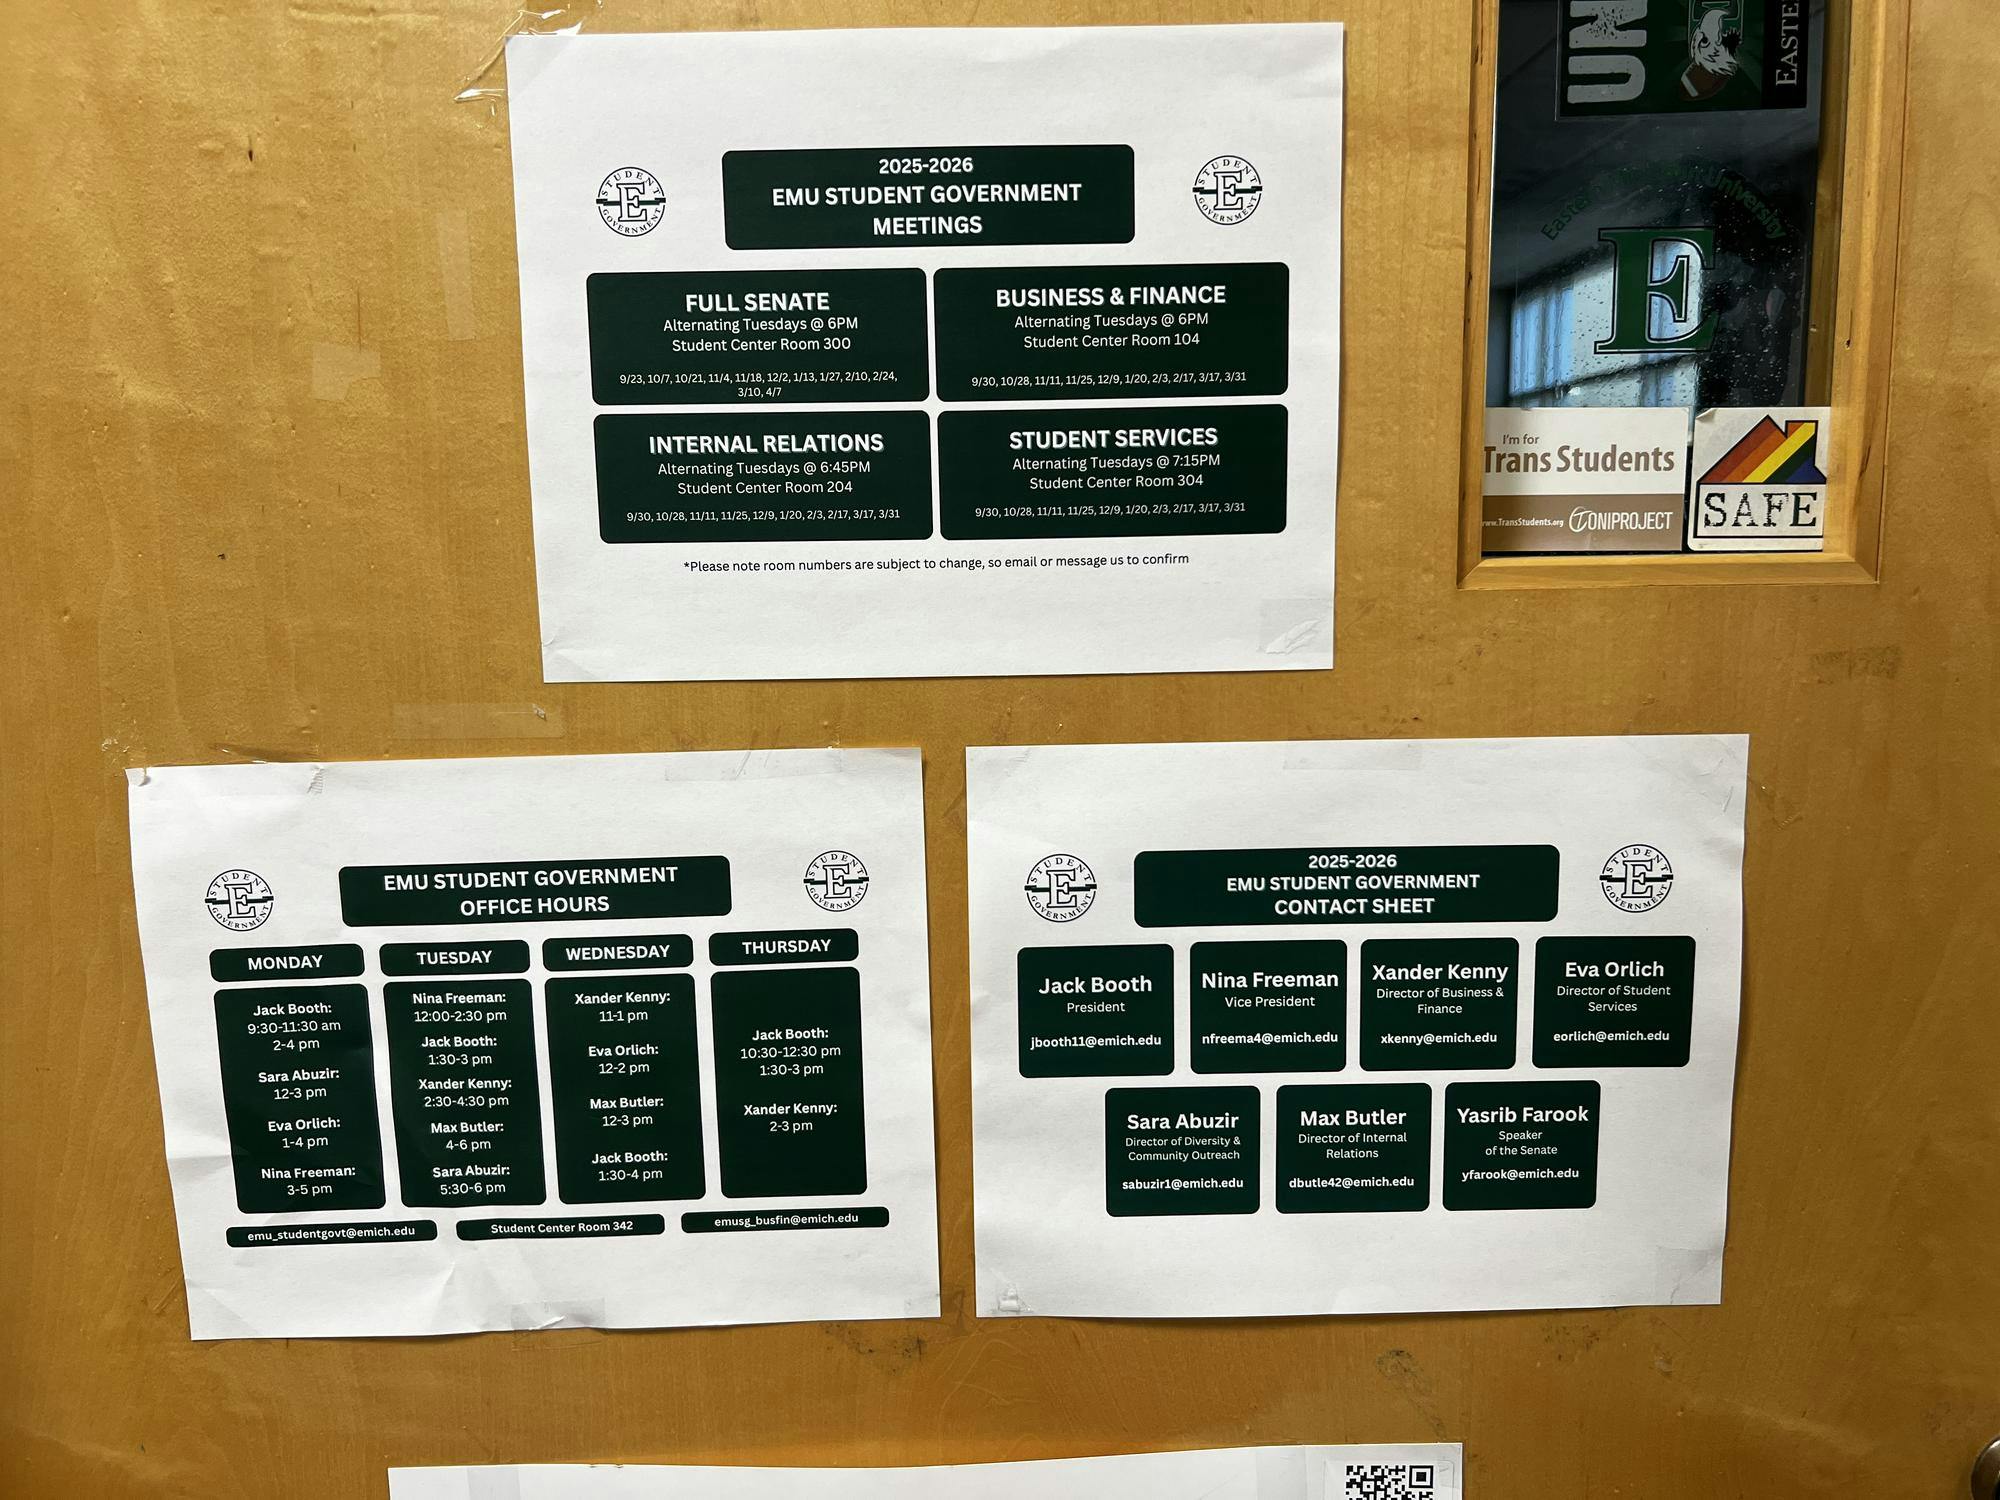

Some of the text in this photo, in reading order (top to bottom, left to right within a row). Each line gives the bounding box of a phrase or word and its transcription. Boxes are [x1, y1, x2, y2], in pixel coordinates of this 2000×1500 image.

[879, 157, 974, 174] 2025-2026
[601, 170, 661, 196] STUDENT
[772, 183, 1082, 206] EMU STUDENT GOVERNMENT
[602, 208, 661, 234] GOVERNMENT
[873, 215, 983, 235] MEETINGS
[996, 285, 1226, 308] BUSINESS & FINANCE
[1594, 227, 1719, 355] E
[686, 292, 830, 312] FULL SENATE
[663, 316, 858, 334] Alternating Tuesdays @ 6PM
[672, 337, 851, 352] Student Center Room 300
[649, 433, 884, 454] INTERNAL RELATIONS
[1010, 427, 1218, 450] STUDENT SERVICES
[1523, 434, 1540, 445] for
[1484, 444, 1675, 474] Trans Students
[975, 502, 1245, 518] 9/30, 10/28, 11/11, 11/25, 12/9, 1/20, 2/3, 2/17, 3/17, 3/31
[1703, 491, 1818, 528] SAFE
[733, 562, 760, 571] note
[764, 562, 795, 571] room
[799, 560, 852, 570] numbers
[854, 561, 874, 570] are
[876, 558, 920, 572] subject
[924, 559, 936, 569] to
[939, 558, 985, 570] change,
[988, 559, 1002, 568] so
[1005, 556, 1037, 568] email
[1040, 558, 1053, 567] or
[1056, 556, 1107, 568] message
[1110, 557, 1124, 566] us
[1127, 556, 1139, 565] to
[1142, 553, 1189, 564] confirm
[1308, 854, 1397, 869] 2025-2026
[1606, 848, 1669, 873] STUDENT
[210, 872, 269, 897] STUDENT
[384, 866, 678, 891] EMU STUDENT GOVERNMENT
[1227, 874, 1480, 892] EMU STUDENT GOVERNMENT
[1605, 884, 1668, 910] GOVERNMENT
[460, 896, 610, 916] OFFICE HOURS
[1274, 898, 1435, 915] CONTACT SHEET
[212, 904, 269, 929] GOVERNMENT
[565, 944, 670, 961] WEDNESDAY
[742, 939, 831, 955] THURSDAY
[248, 954, 323, 970] MONDAY
[416, 950, 492, 965] TUESDAY
[1372, 964, 1509, 983] Xander Kenny
[1565, 960, 1664, 978] Eva Orlich
[1038, 975, 1152, 994] Jack Booth
[1202, 972, 1338, 988] Nina Freeman
[1376, 986, 1504, 999] Director of Business &
[1557, 984, 1671, 996] Director of Student
[253, 1002, 332, 1016] Jack Booth:
[1067, 1001, 1126, 1013] President
[1224, 995, 1316, 1008] Vice President
[1418, 1004, 1462, 1014] Finance
[1588, 1001, 1638, 1012] Services
[247, 1020, 341, 1035] 9:30-11:30 am
[752, 1027, 829, 1041] Jack Booth:
[1030, 1034, 1162, 1050] jbooth11@emich.edu
[1202, 1031, 1338, 1045] nfreema4@emich.edu
[1380, 1032, 1497, 1046] xkenny@emich.edu
[1553, 1030, 1670, 1043] eorlich@emich.edu
[740, 1045, 841, 1059] 10:30-12:30 pm
[760, 1064, 824, 1077] 1:30-3 pm
[744, 1102, 838, 1116] Xander Kenny:
[1300, 1108, 1407, 1126] Max Butler
[1456, 1105, 1589, 1124] Yasrib Farook
[770, 1120, 813, 1134] 2-3 pm
[1127, 1112, 1239, 1130] Sara Abuzir
[1126, 1136, 1241, 1148] Director of Diversity &
[1298, 1132, 1407, 1144] Director of Internal
[1498, 1130, 1543, 1142] Speaker
[1128, 1150, 1240, 1162] Community Outreach
[1326, 1148, 1379, 1159] Relations
[1485, 1145, 1558, 1156] of the Senate
[1289, 1176, 1414, 1189] dbutle42@emich.edu
[1461, 1168, 1579, 1182] yfarook@emich.edu
[1122, 1177, 1244, 1190] sabuzir1@emich.edu
[491, 1220, 633, 1234] Student Center Room 342
[714, 1213, 858, 1228] emusg_busfin@emich.edu
[247, 1226, 415, 1242] emu_studentgovt@emich.edu
